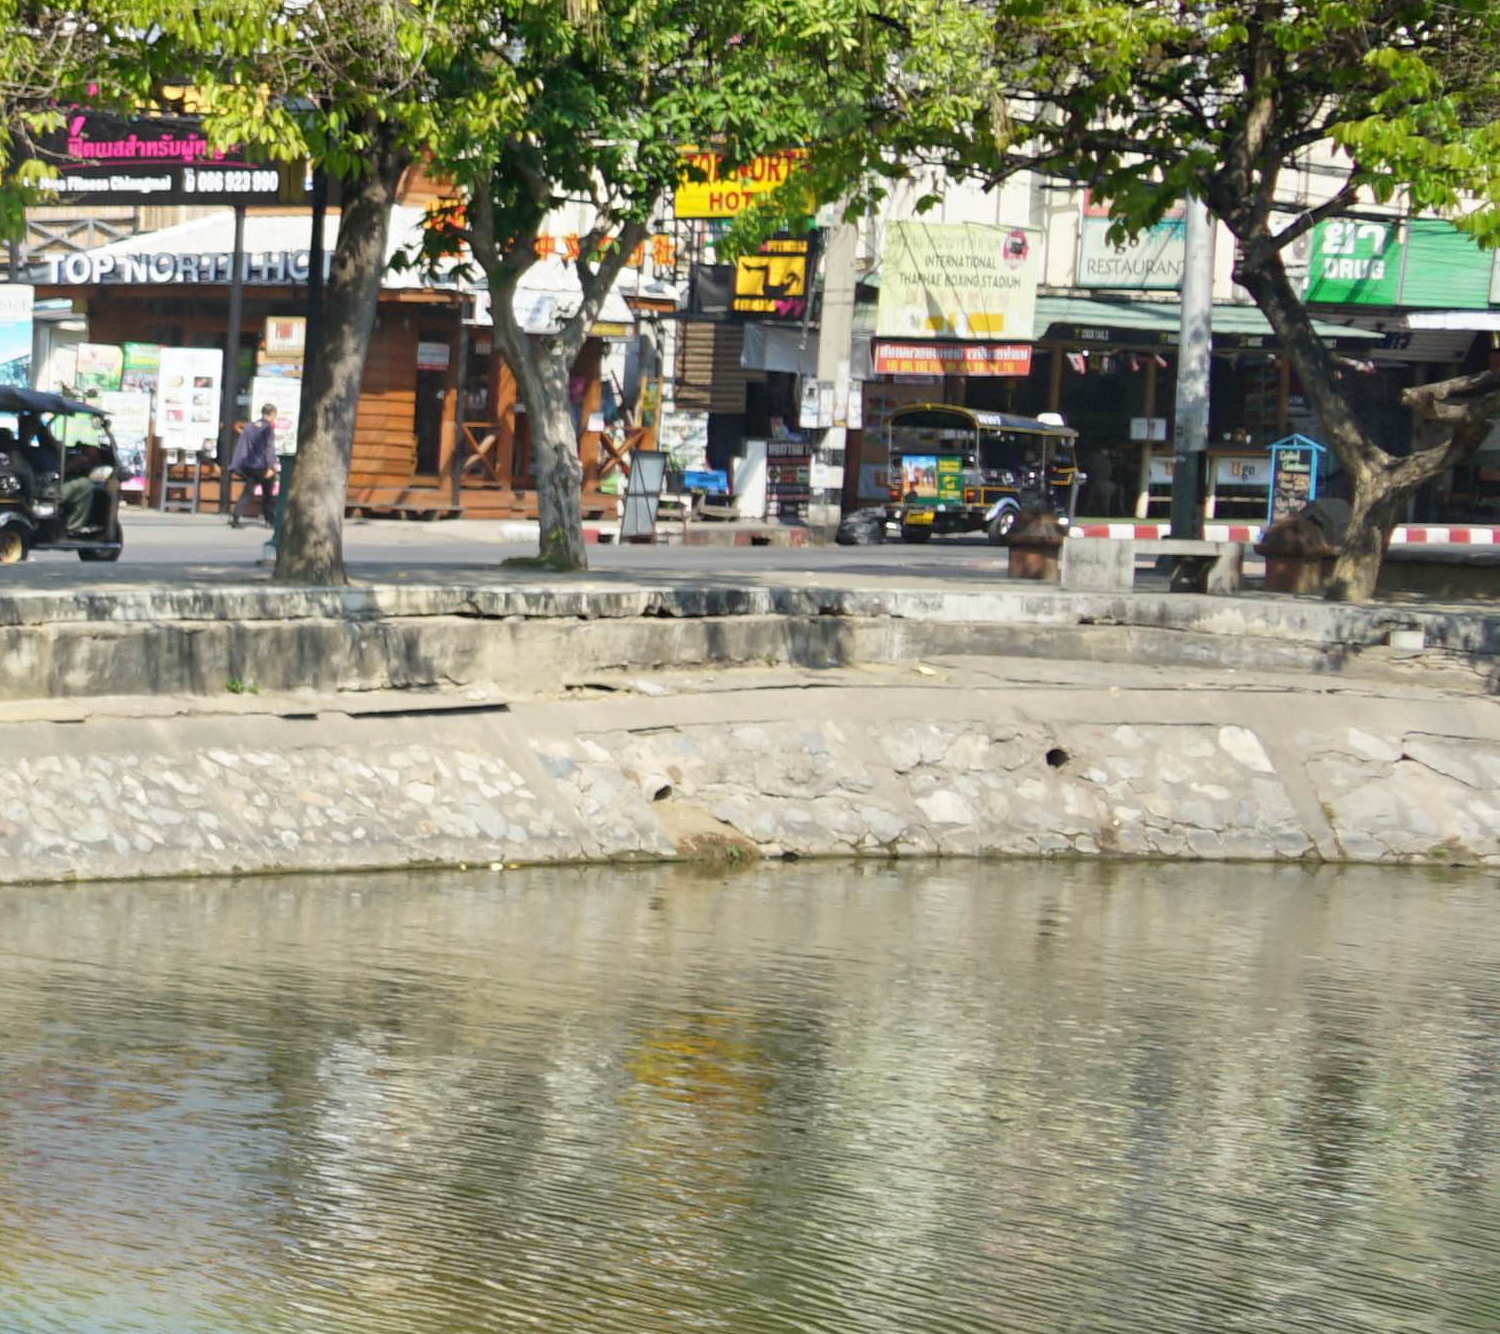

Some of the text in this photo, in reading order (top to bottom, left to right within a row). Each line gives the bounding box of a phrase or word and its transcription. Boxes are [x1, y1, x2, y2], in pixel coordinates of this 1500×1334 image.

[735, 150, 813, 182] ORT
[1323, 222, 1387, 255] ยา
[44, 249, 333, 284] TOP NORTH HOT
[925, 254, 996, 269] INTERNATIONAL
[1324, 258, 1384, 280] DRUG
[945, 273, 979, 287] BOXING
[981, 275, 1021, 289] STADIUM
[1231, 460, 1256, 481] Ugo
